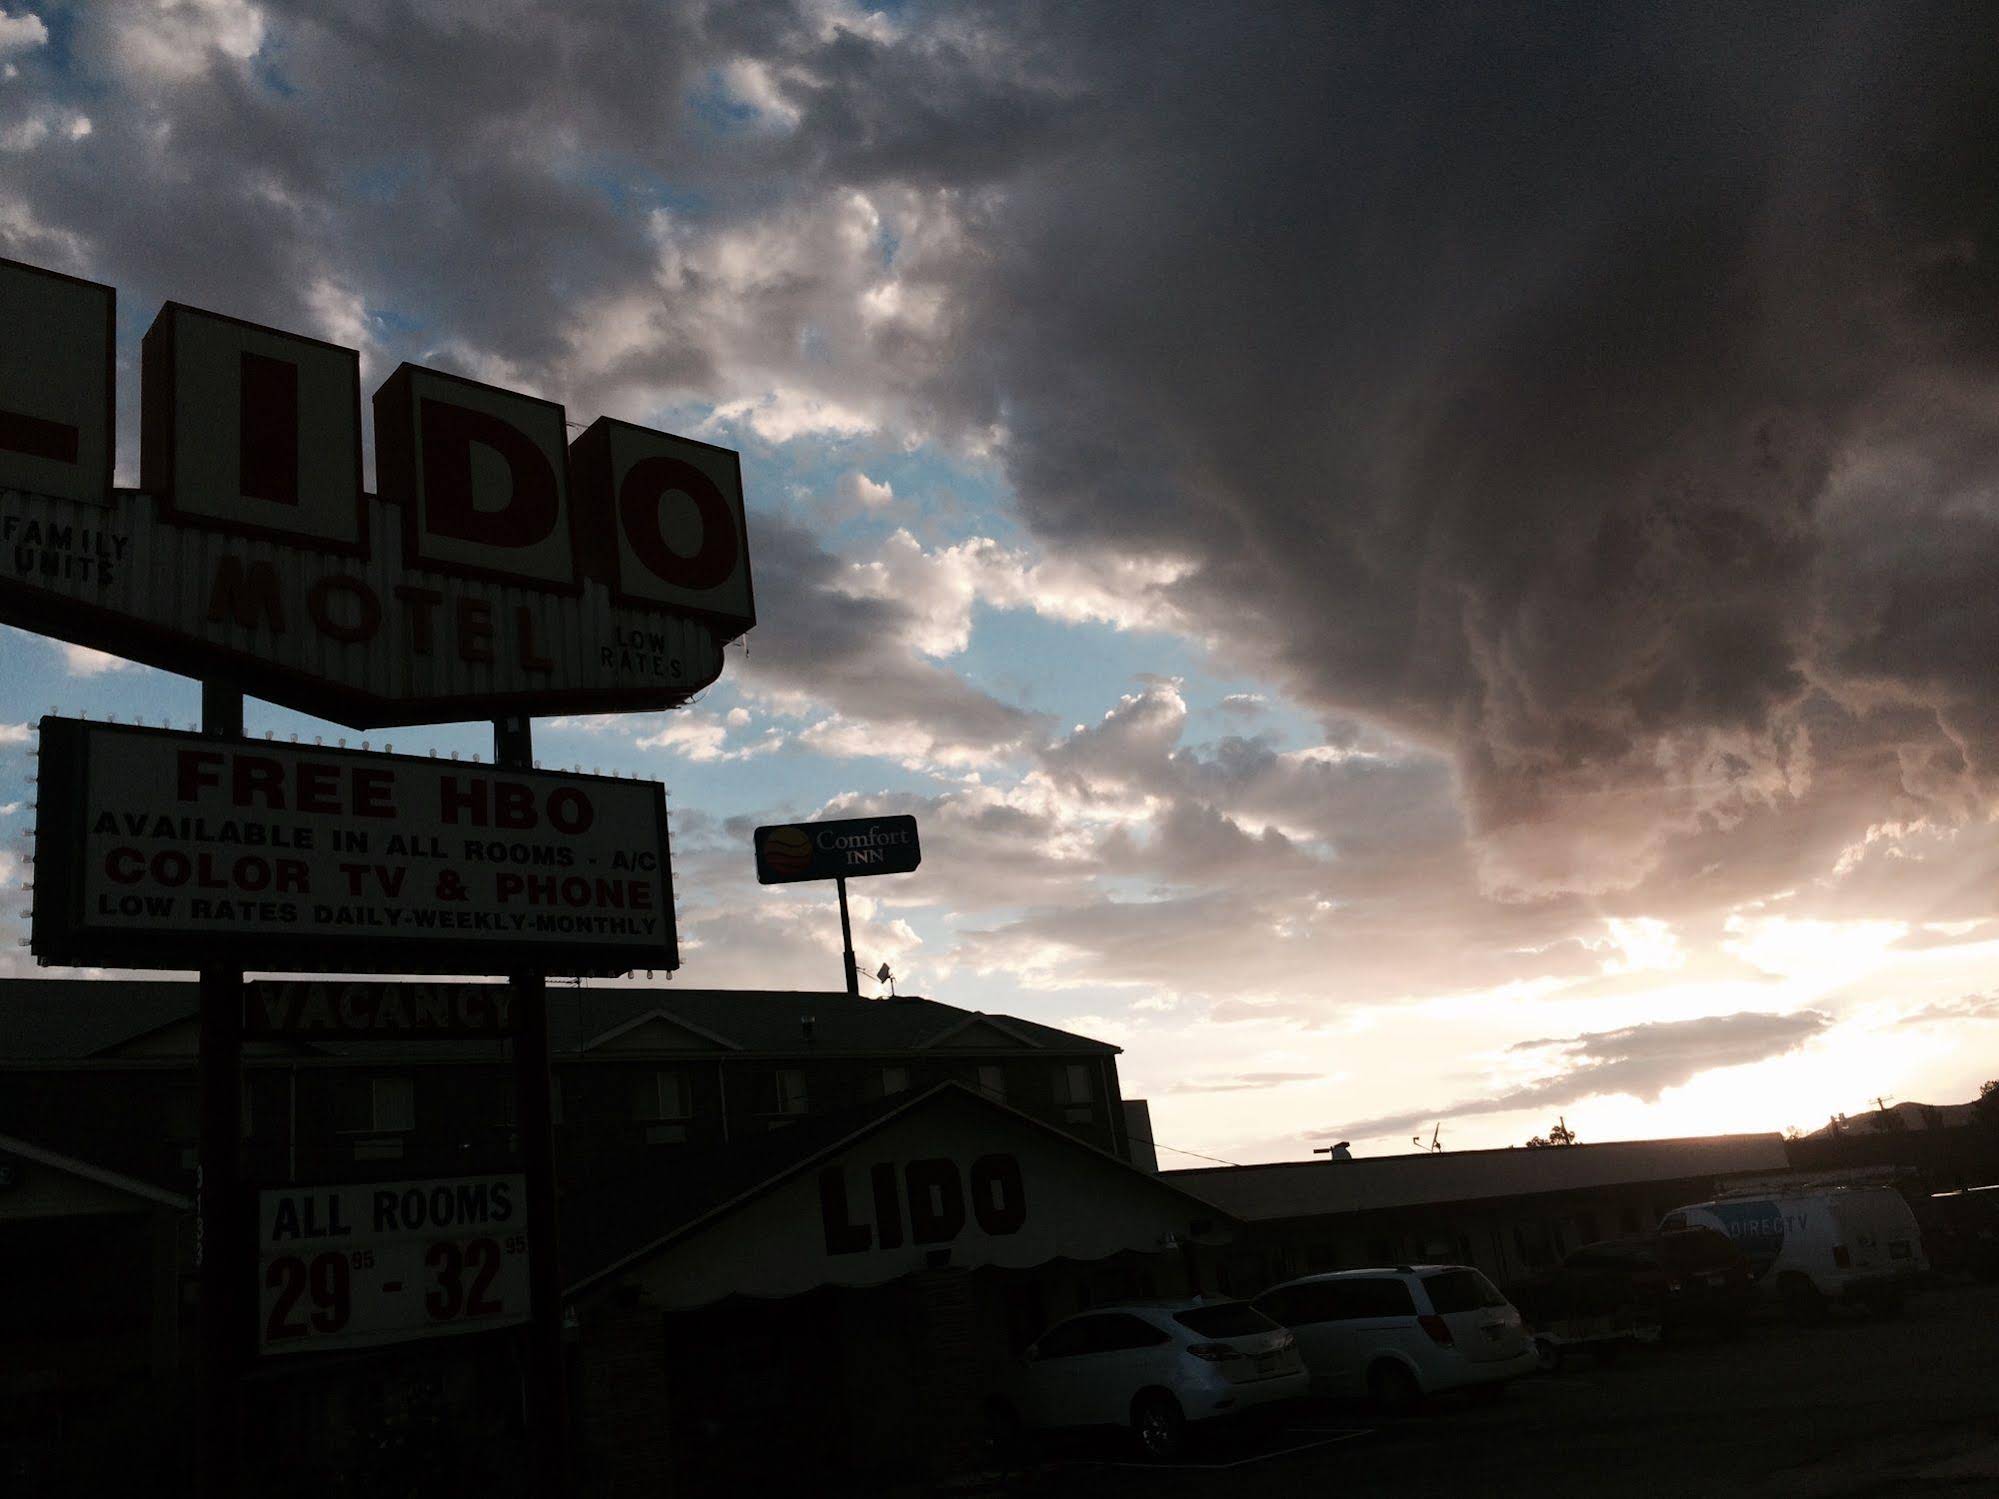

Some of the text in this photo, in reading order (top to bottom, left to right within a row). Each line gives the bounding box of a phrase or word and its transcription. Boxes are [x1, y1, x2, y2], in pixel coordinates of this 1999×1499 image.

[3, 515, 129, 561] FAMILY
[14, 545, 114, 585] UNITS
[207, 556, 554, 672] MOTEL
[600, 645, 682, 679] RATES
[616, 625, 664, 655] LOW
[177, 750, 594, 835] FREE HBO
[94, 811, 314, 851] AVAILABLE
[333, 829, 369, 855] IN
[386, 833, 448, 860] ALL
[464, 839, 574, 867] ROOMS
[611, 850, 657, 873] A/C
[815, 825, 911, 851] Comfort
[847, 848, 886, 865] INN
[105, 846, 653, 910] COLOR TV & PHONE
[99, 894, 175, 917] LOW
[191, 899, 297, 922] RATES
[257, 983, 514, 1033] VACANCY
[273, 1181, 513, 1241] ALL ROOMS
[819, 1152, 1027, 1257] LIDO
[1727, 1213, 1808, 1237] DIRECTV
[267, 1252, 350, 1342] 29
[425, 1238, 502, 1320] 32
